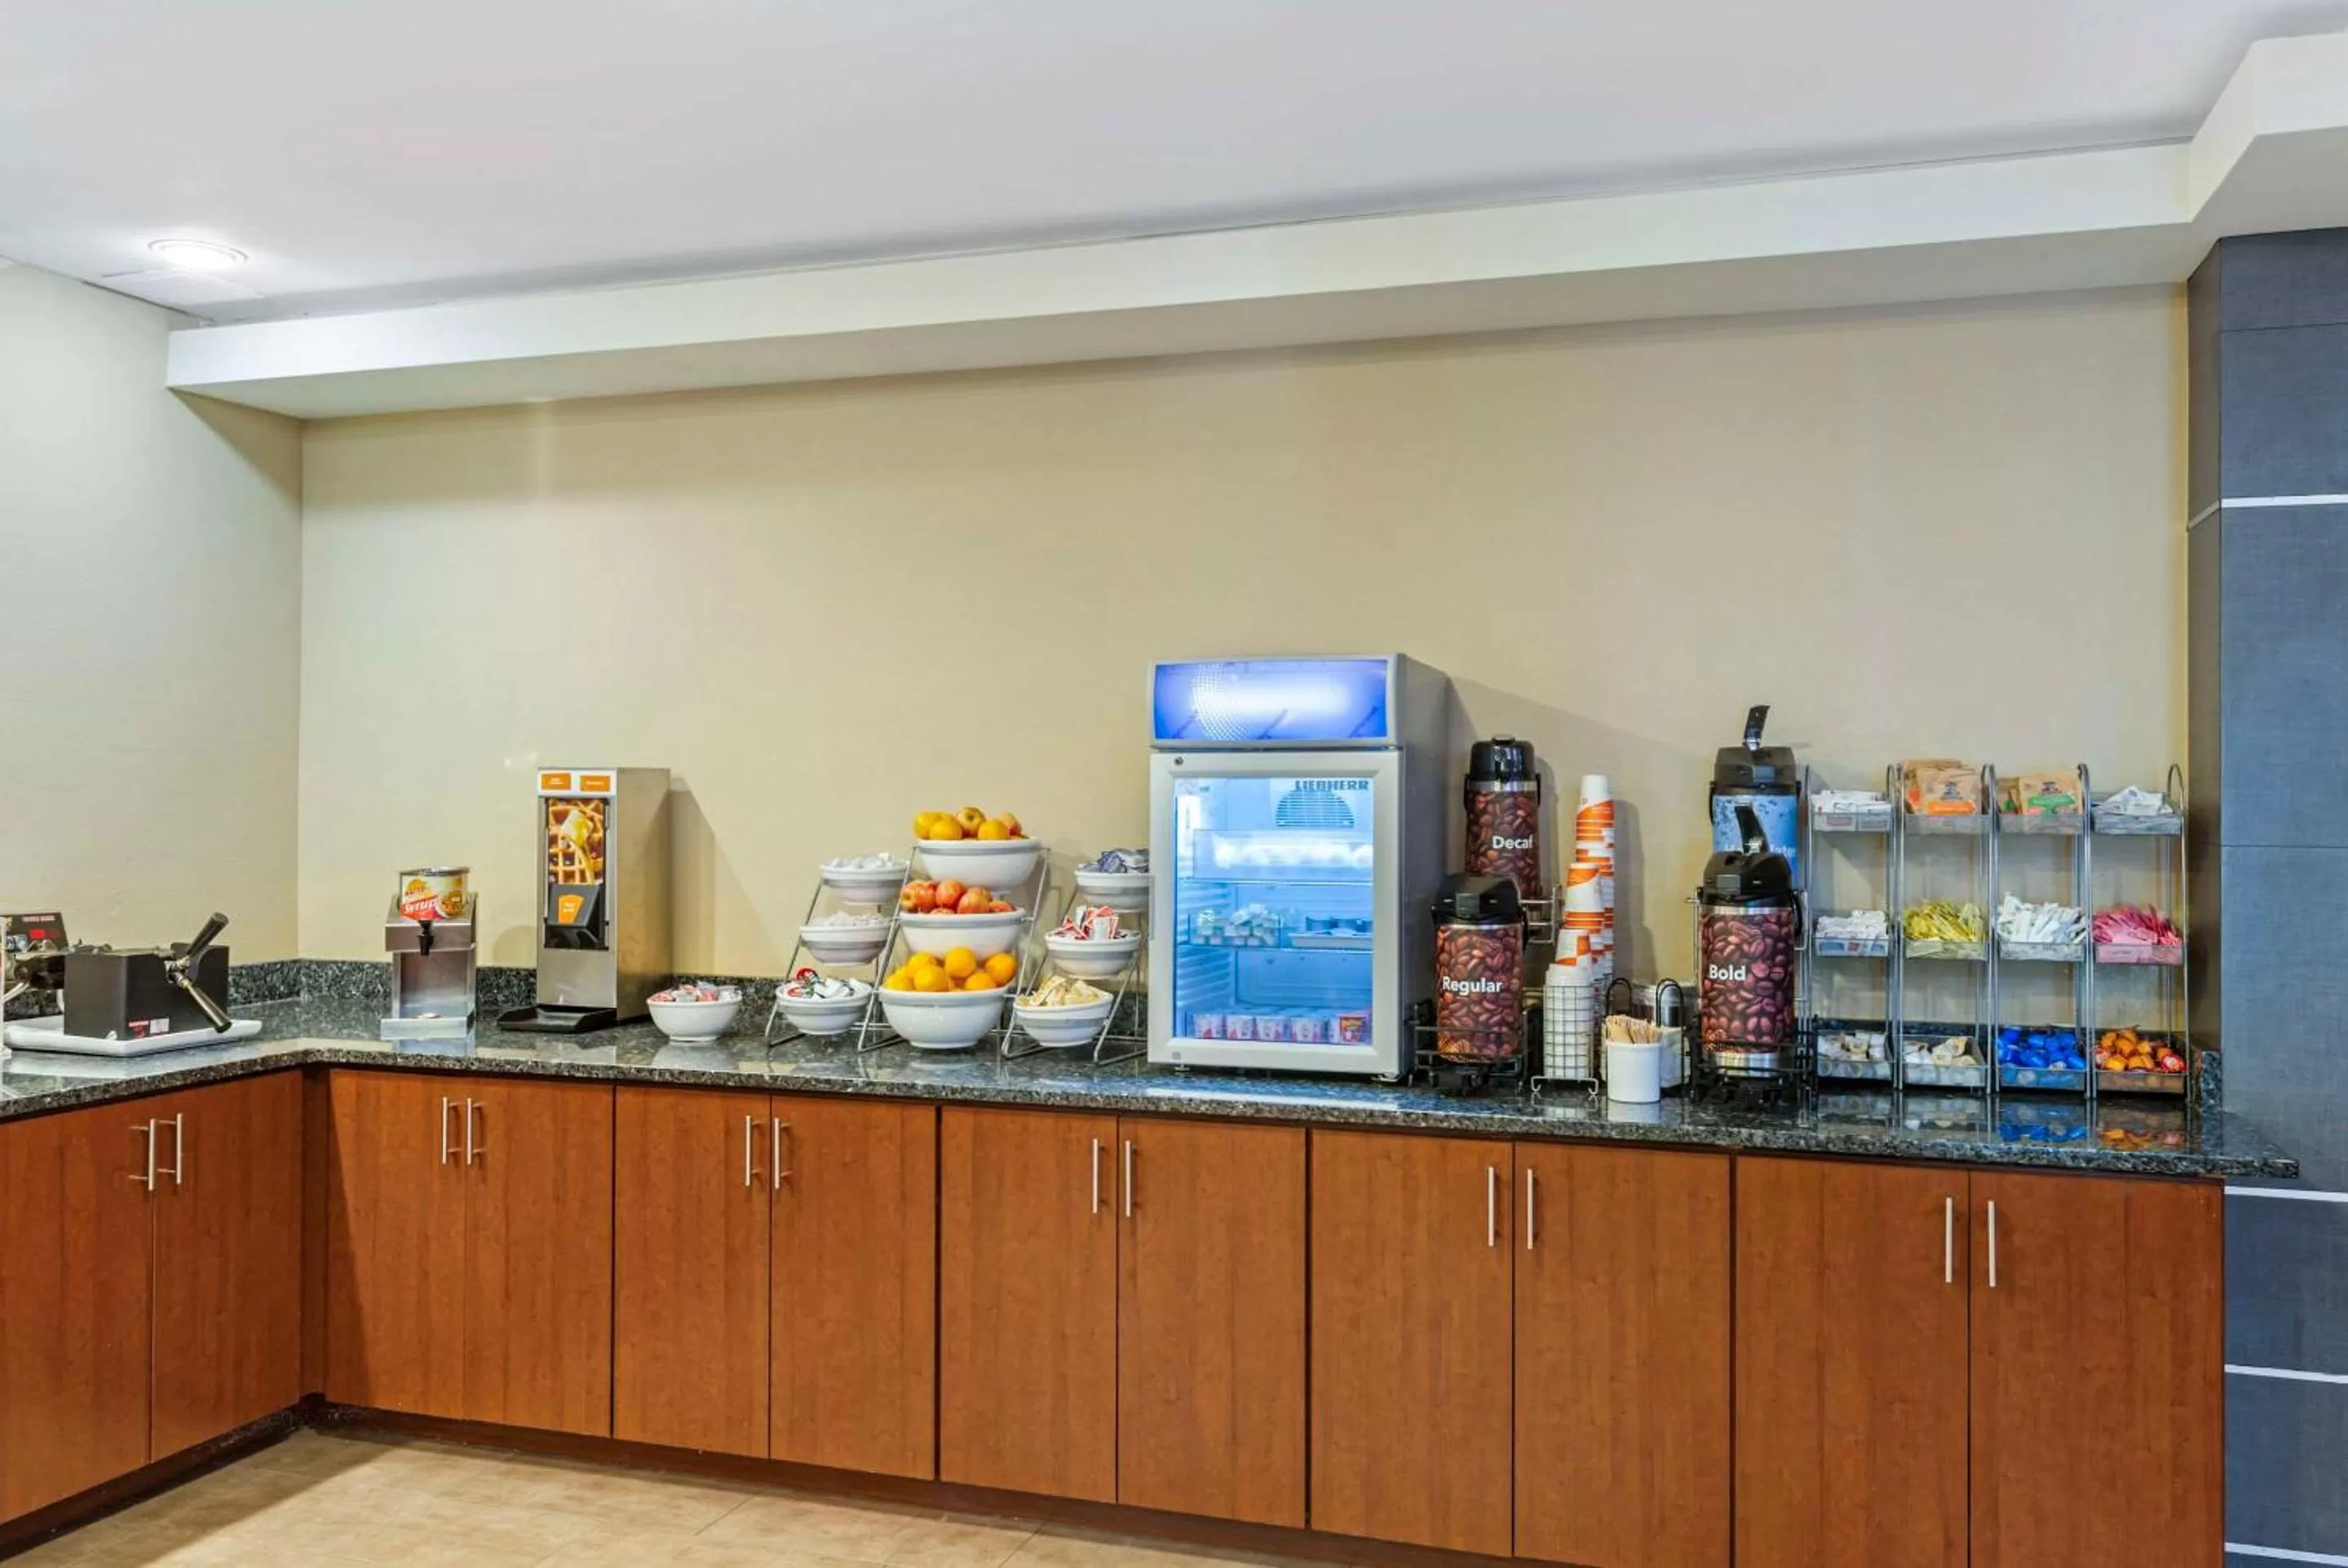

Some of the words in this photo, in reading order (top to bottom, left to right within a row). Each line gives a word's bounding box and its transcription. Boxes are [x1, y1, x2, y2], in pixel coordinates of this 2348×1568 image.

[1294, 780, 1369, 791] LIEBHERR
[1492, 833, 1533, 849] Decaf
[1709, 964, 1746, 981] Bold
[1442, 975, 1503, 996] Regular
